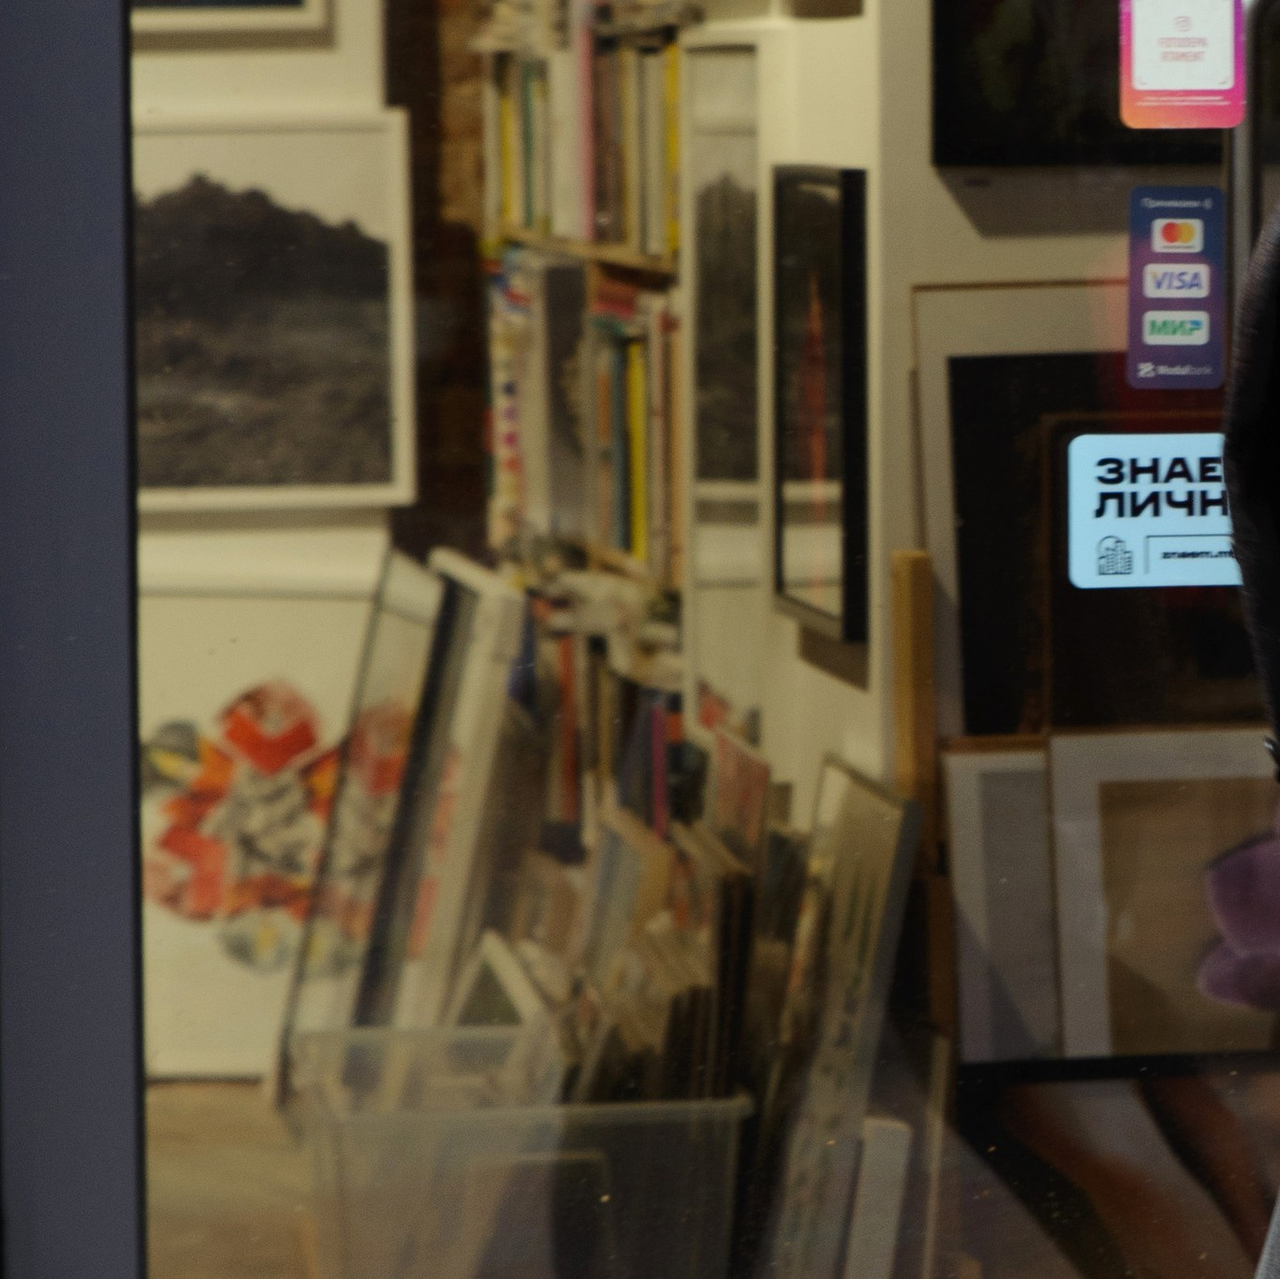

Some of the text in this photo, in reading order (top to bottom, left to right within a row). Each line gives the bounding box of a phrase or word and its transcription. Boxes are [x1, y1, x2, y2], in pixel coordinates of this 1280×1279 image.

[1152, 271, 1203, 290] VISA
[1150, 319, 1204, 337] МИР
[1096, 457, 1223, 485] ЗНАЕ
[1095, 490, 1229, 518] ЛИЧН
